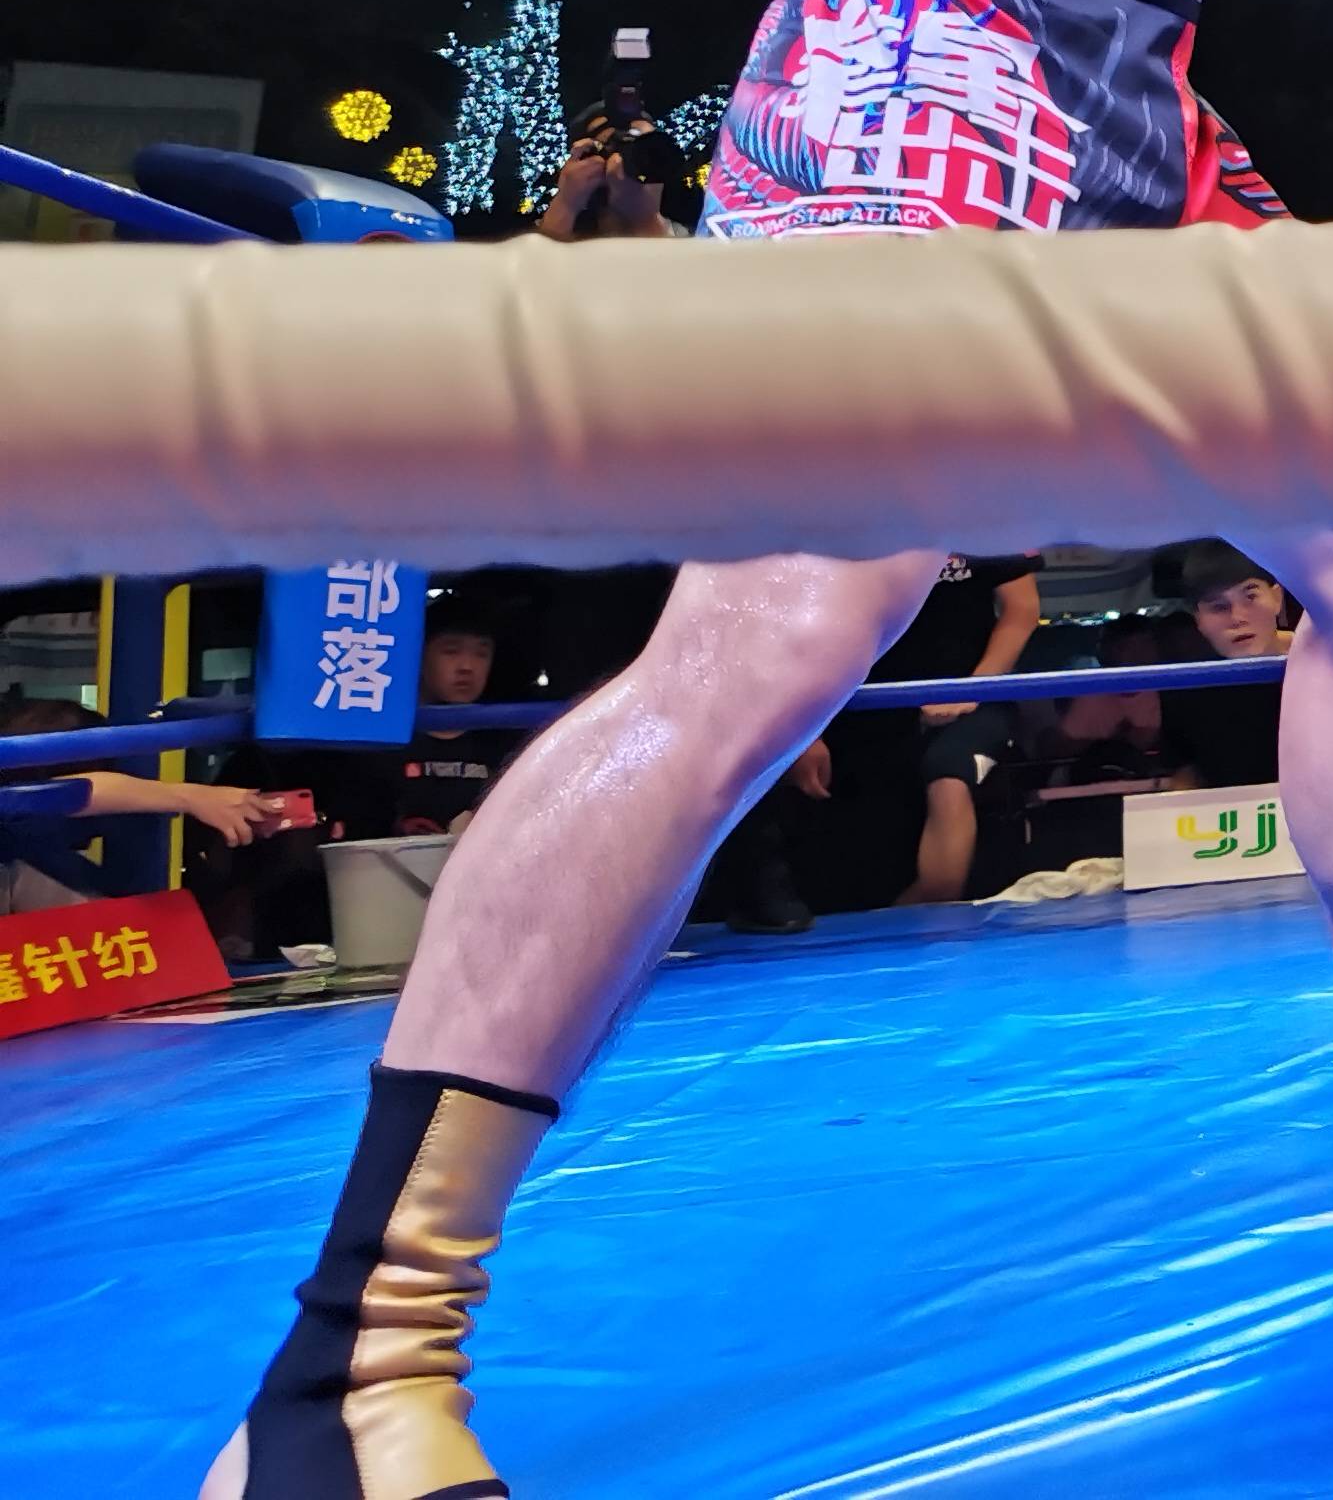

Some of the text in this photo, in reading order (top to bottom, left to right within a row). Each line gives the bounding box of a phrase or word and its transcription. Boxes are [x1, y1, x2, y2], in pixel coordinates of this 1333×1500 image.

[795, 208, 846, 225] STAR
[850, 207, 932, 226] ATTACK
[313, 560, 400, 712] 部落
